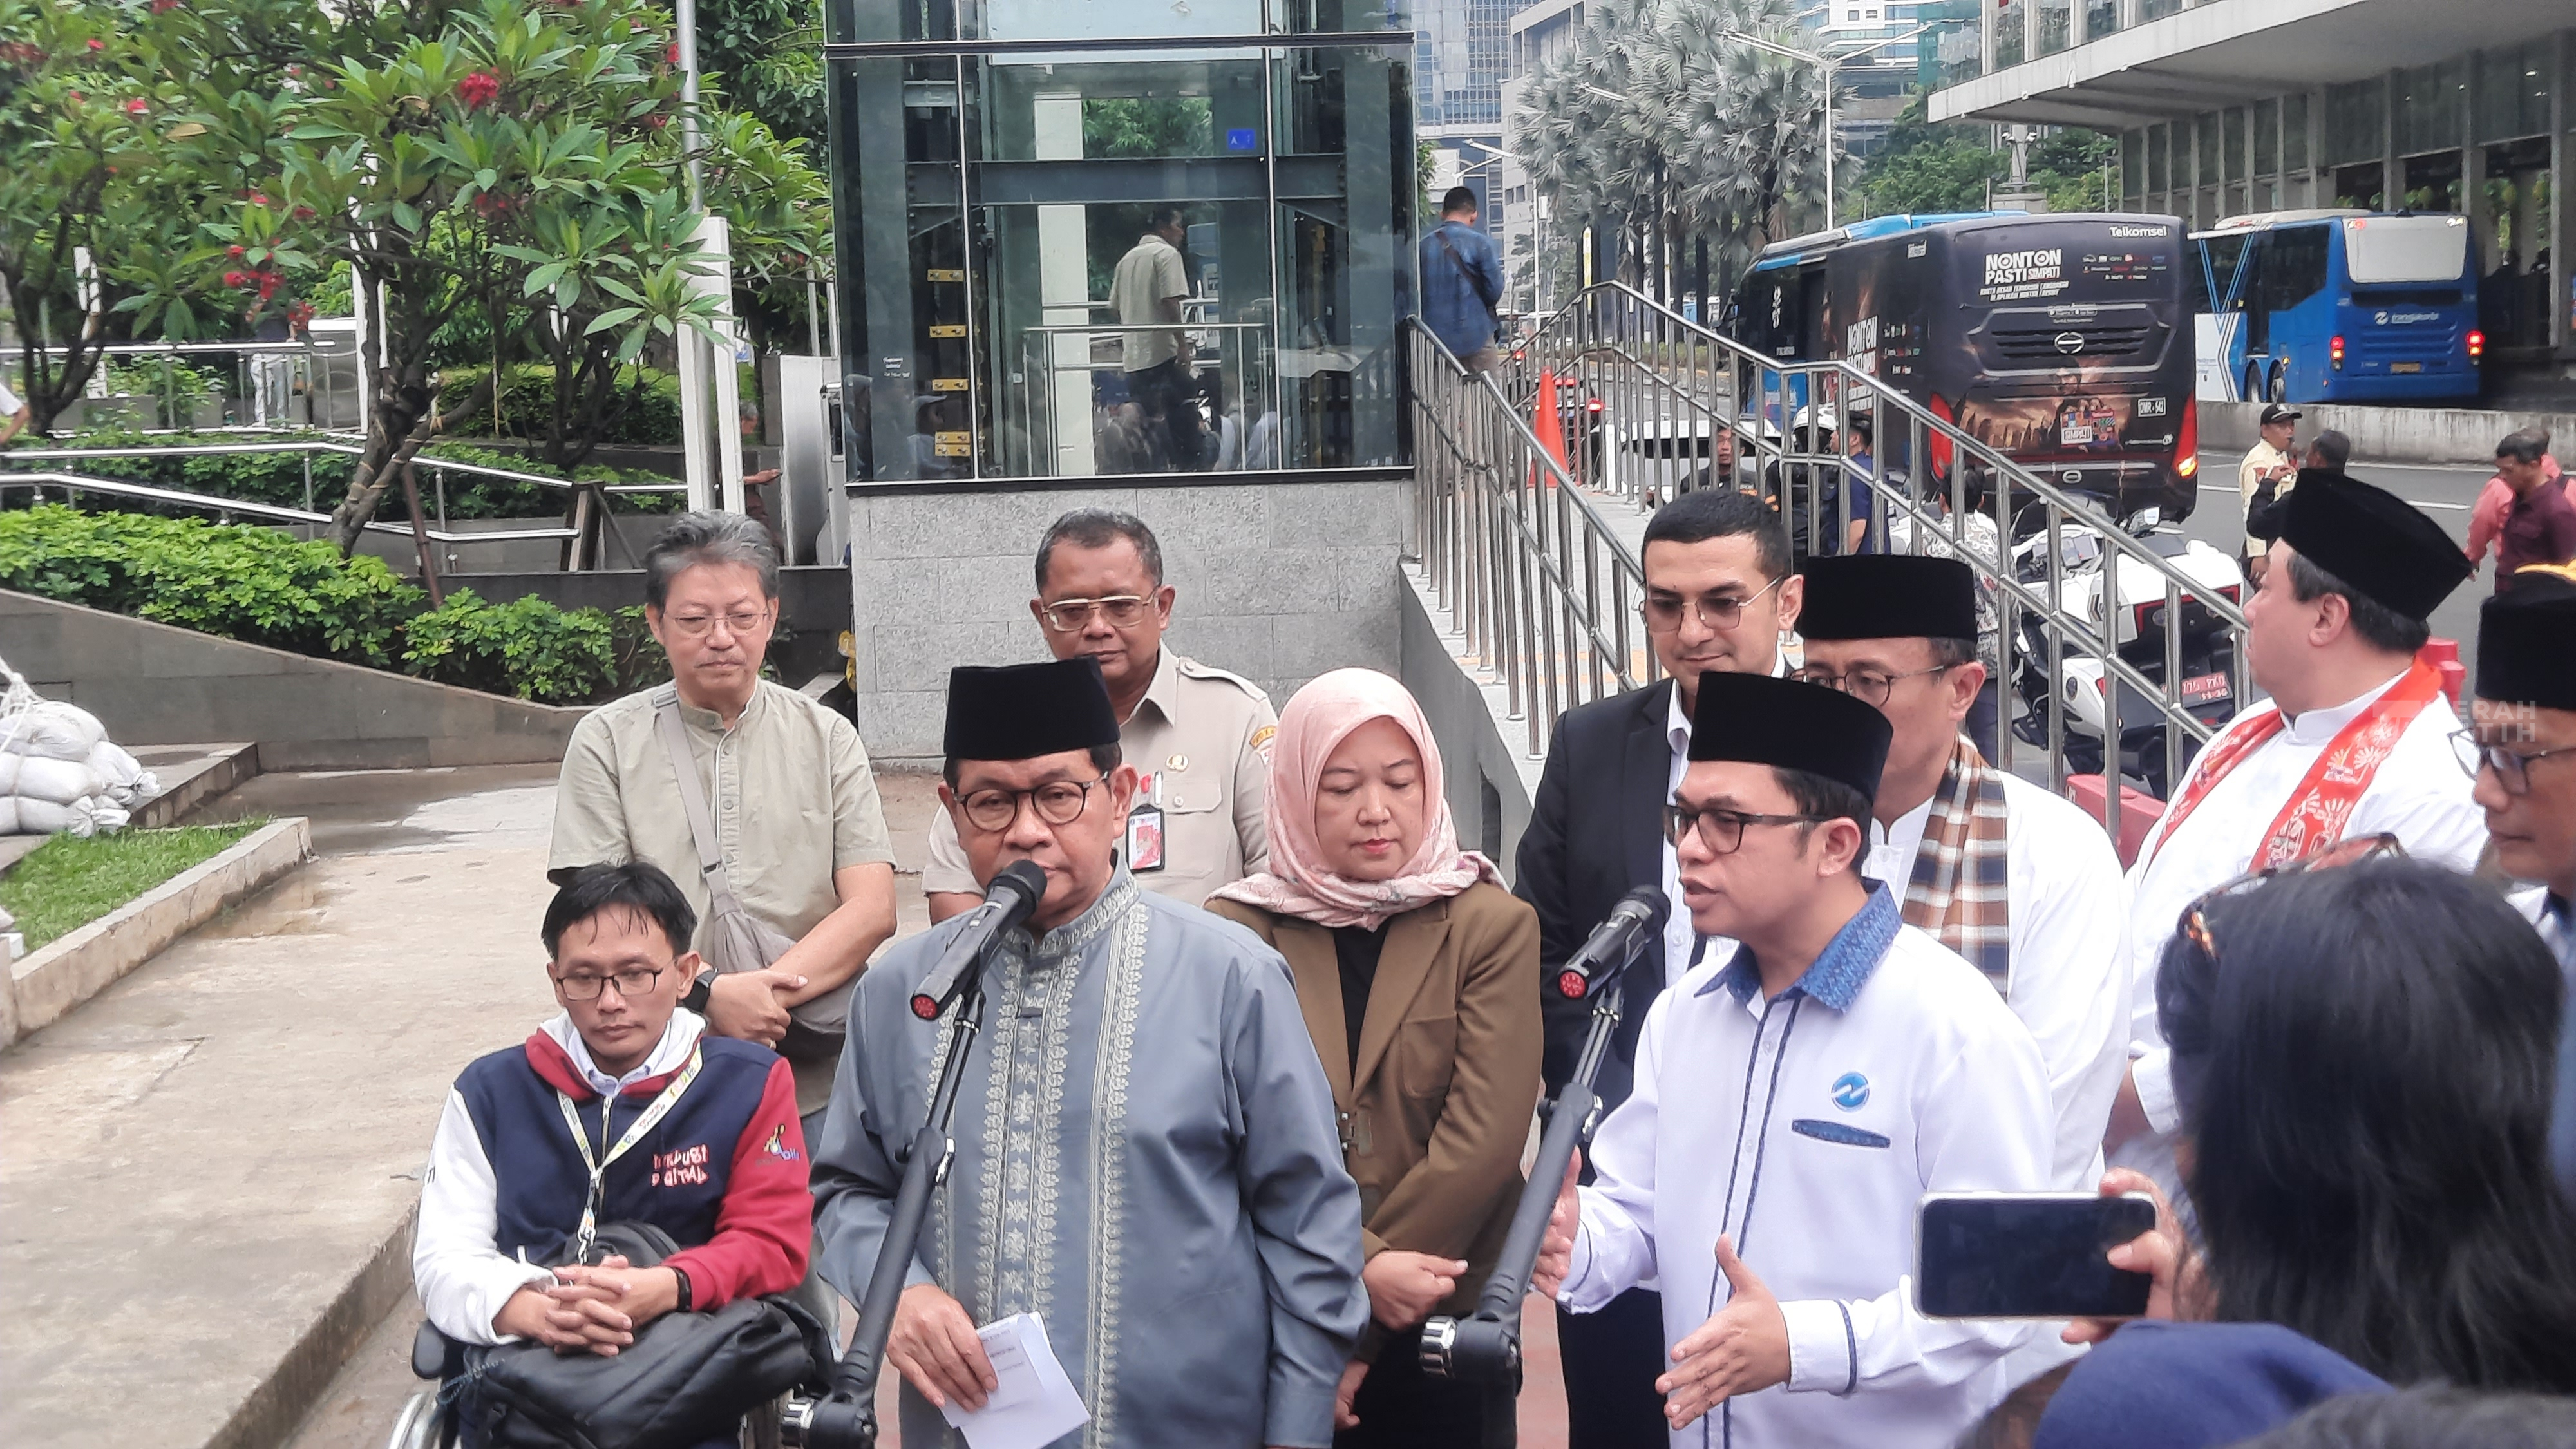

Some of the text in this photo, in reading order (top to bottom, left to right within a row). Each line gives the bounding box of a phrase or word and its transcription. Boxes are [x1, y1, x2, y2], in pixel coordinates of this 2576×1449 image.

[2109, 225, 2168, 237] Telkomsel
[1985, 249, 2061, 270] NONTON
[1985, 268, 2027, 285] PASTI
